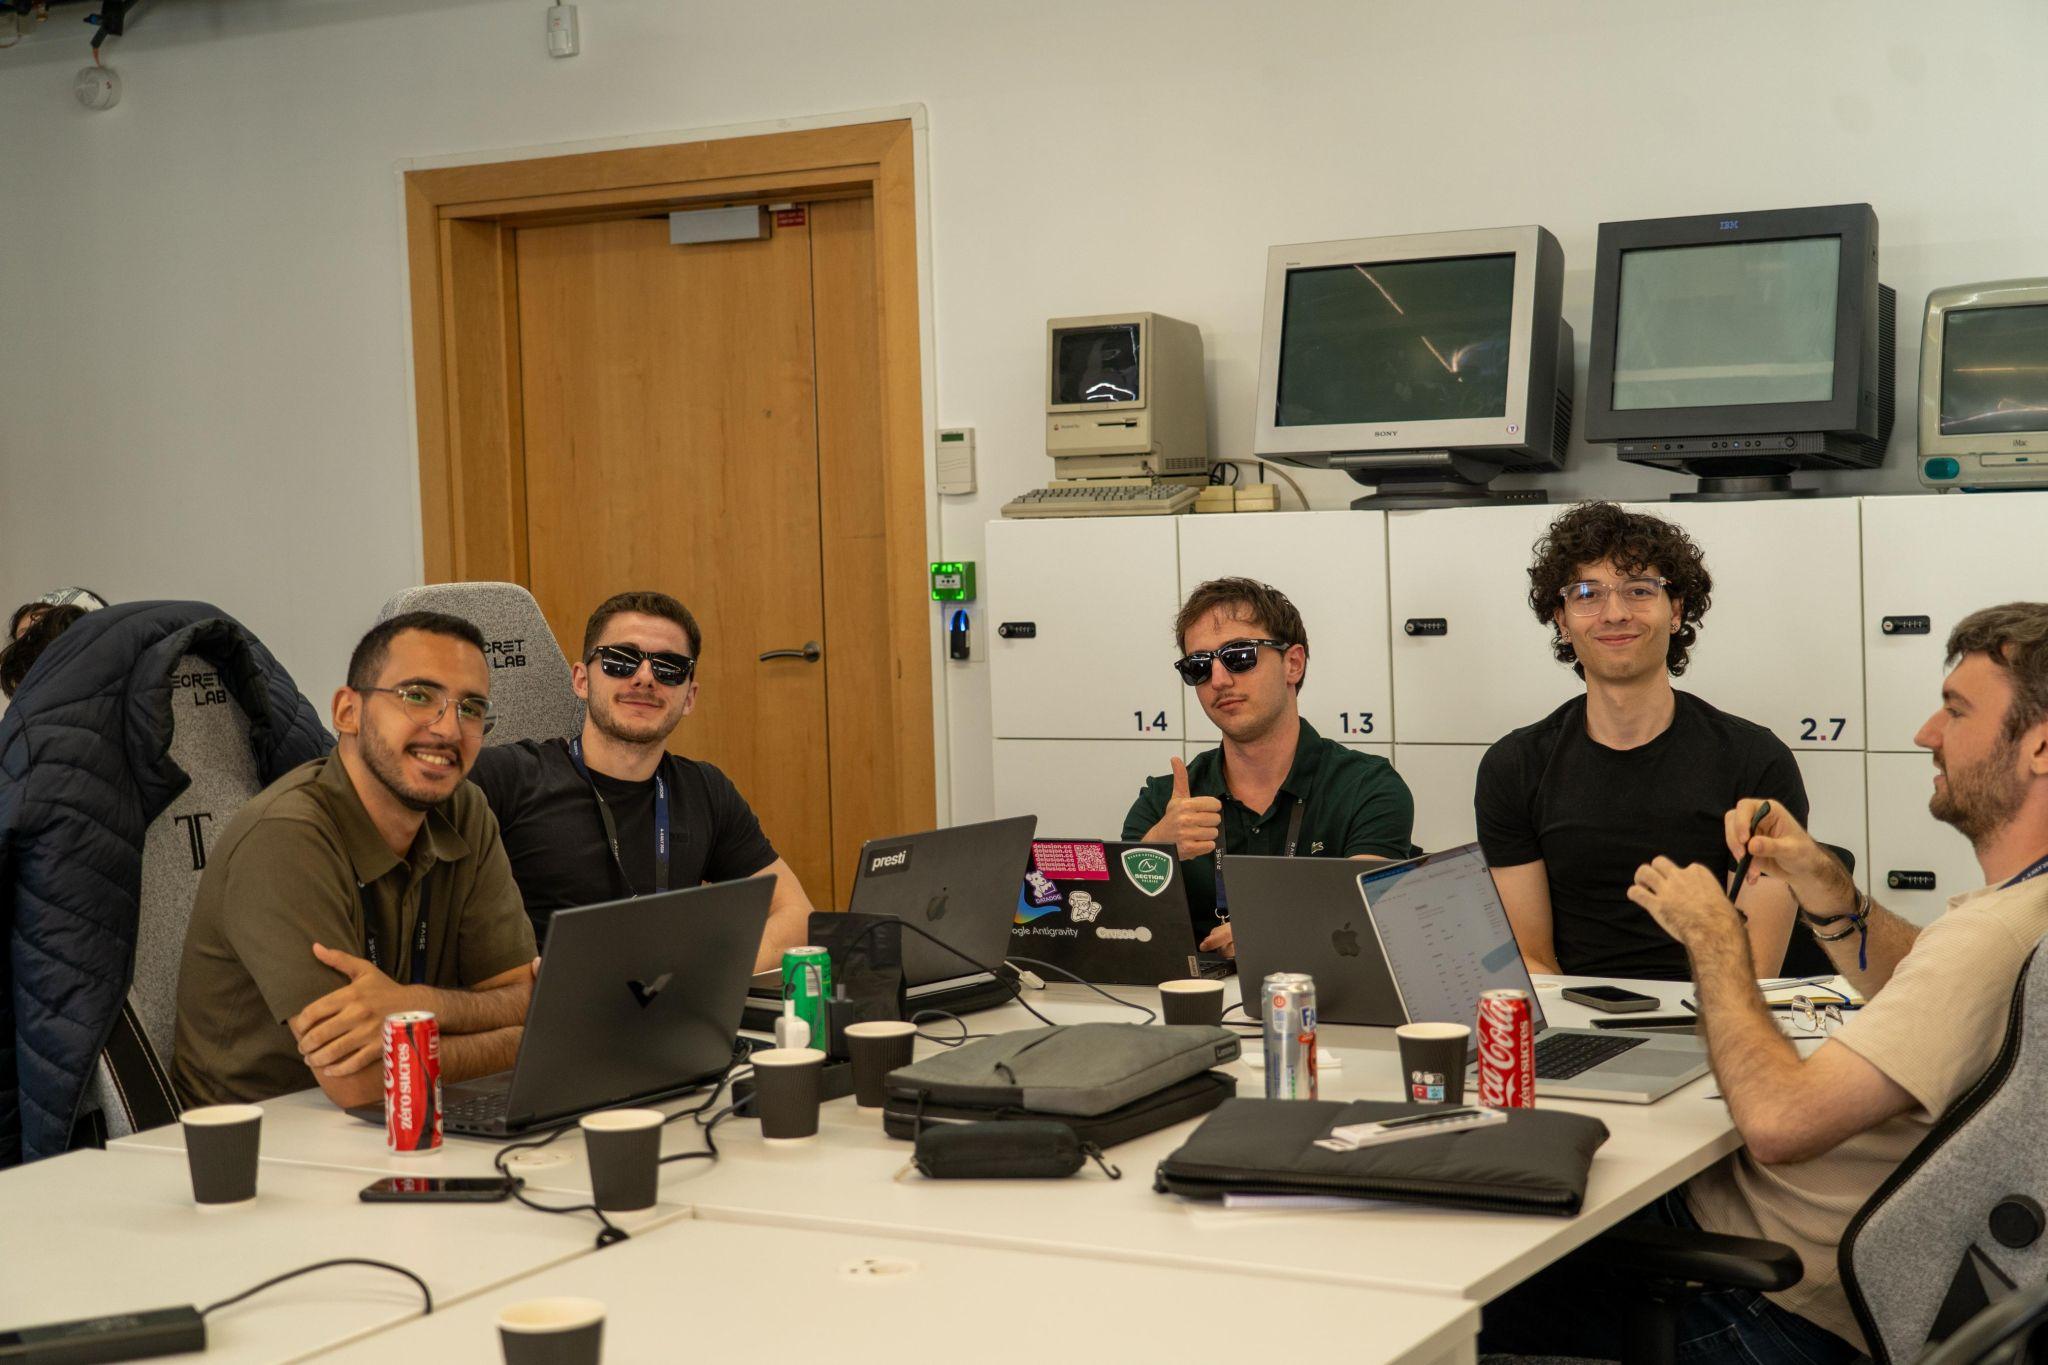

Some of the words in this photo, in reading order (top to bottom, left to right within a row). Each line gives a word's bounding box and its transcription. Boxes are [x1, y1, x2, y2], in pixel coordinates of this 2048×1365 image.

[1719, 220, 1739, 230] IBM
[482, 639, 525, 655] CRET
[493, 655, 526, 668] LAB
[170, 672, 221, 689] ECRET
[194, 689, 227, 706] LAB
[1134, 710, 1168, 731] 1.4
[1339, 712, 1374, 734] 1.3
[1800, 717, 1846, 741] 2.7
[871, 850, 907, 872] presti
[1011, 926, 1031, 937] ogle
[1032, 926, 1079, 939] Antigravity
[1518, 1020, 1530, 1072] sucres
[397, 1043, 412, 1093] sucres
[398, 1094, 412, 1130] zéro
